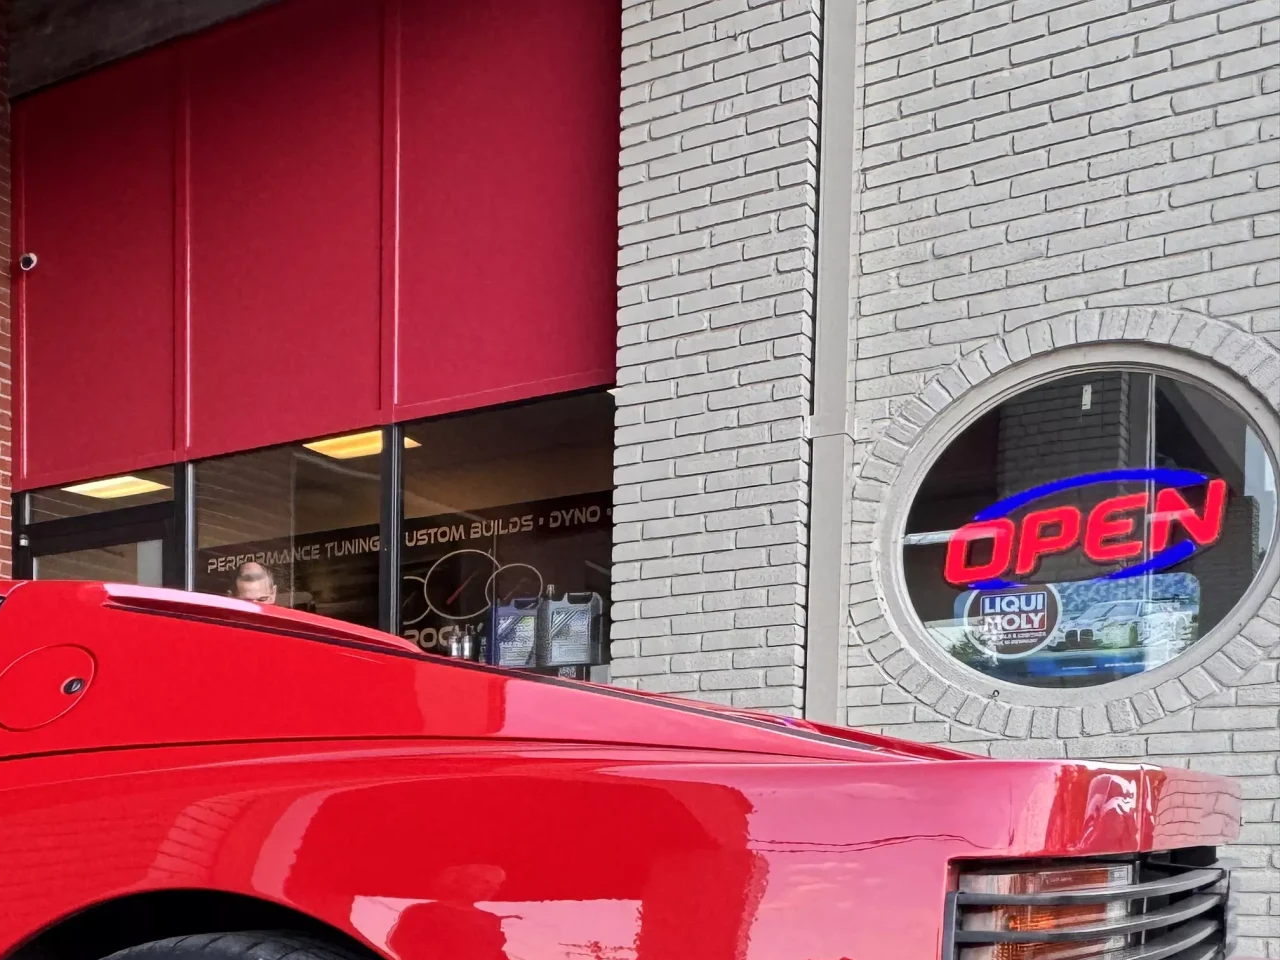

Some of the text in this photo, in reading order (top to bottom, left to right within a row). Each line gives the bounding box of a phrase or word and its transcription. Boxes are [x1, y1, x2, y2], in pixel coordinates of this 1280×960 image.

[207, 505, 601, 574] PERFORMANCE TUNING USTOM BUILDS DYNO
[944, 478, 1227, 584] OPEN
[983, 594, 1044, 614] LIQUI
[983, 612, 1045, 631] MOLY
